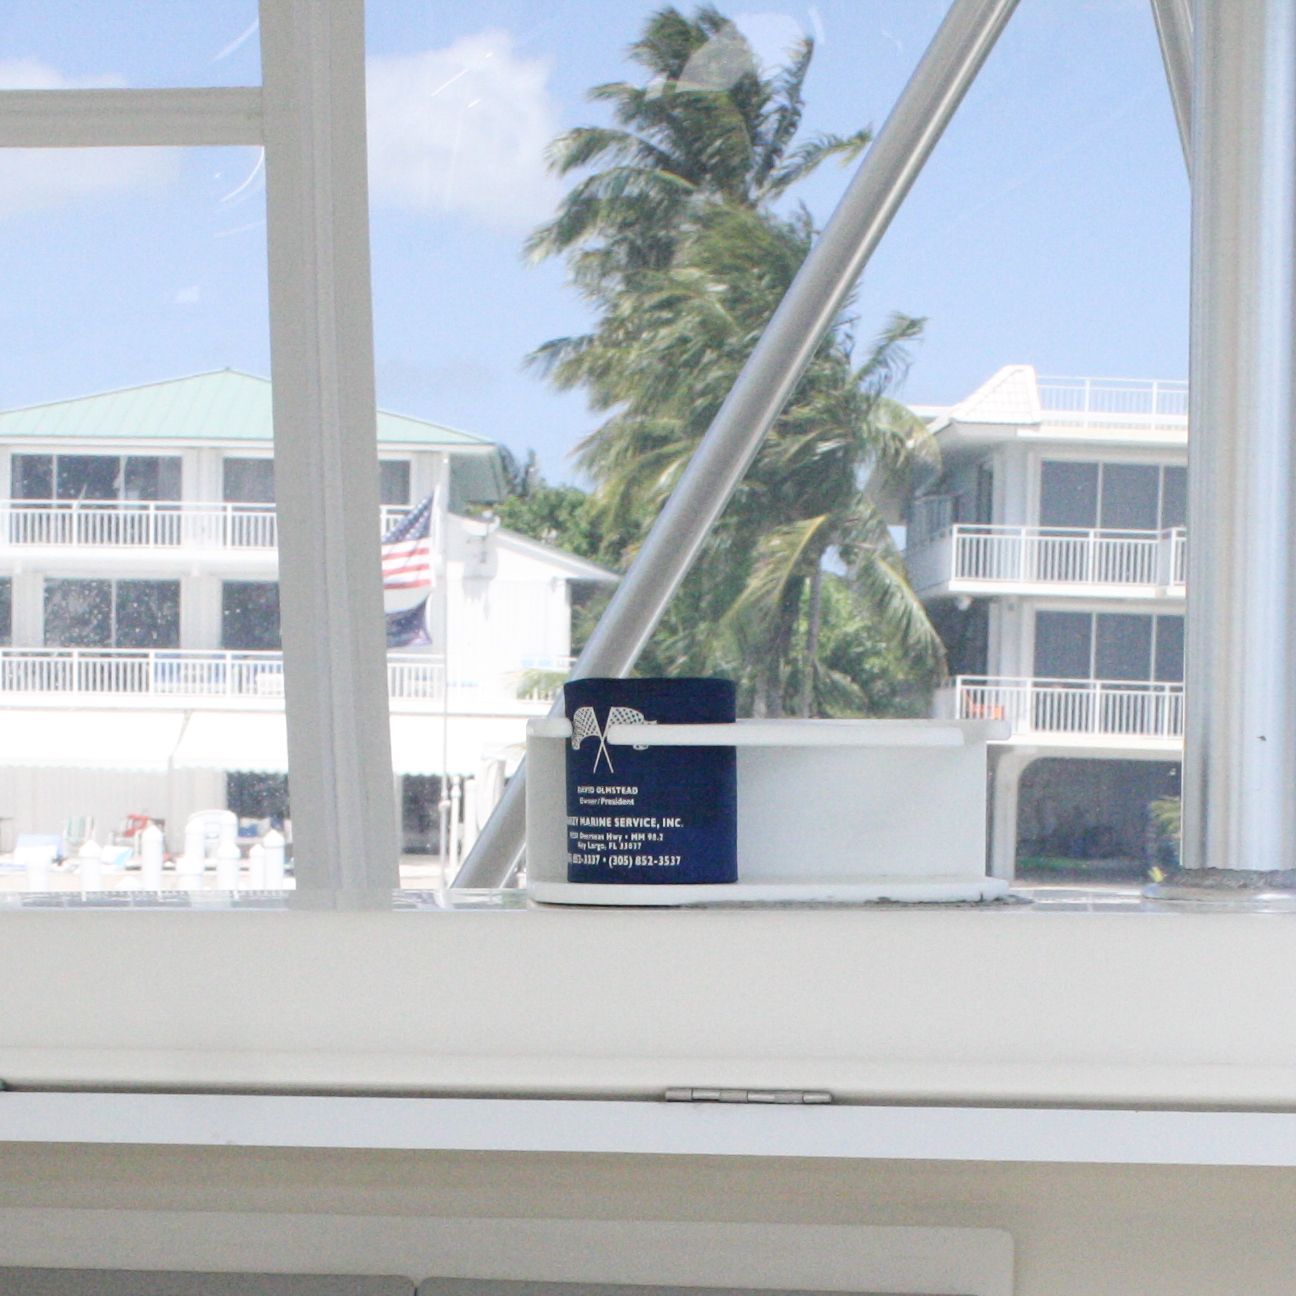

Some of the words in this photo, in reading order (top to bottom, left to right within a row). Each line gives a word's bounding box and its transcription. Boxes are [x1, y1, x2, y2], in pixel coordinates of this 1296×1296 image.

[596, 786, 638, 795] OLMSTEAD
[579, 817, 612, 827] MARINE
[614, 817, 660, 829] SERVICE,
[662, 818, 684, 828] INC.
[606, 833, 623, 843] Hwy
[631, 833, 645, 841] MM
[608, 842, 617, 850] FL
[608, 855, 632, 868] (305)
